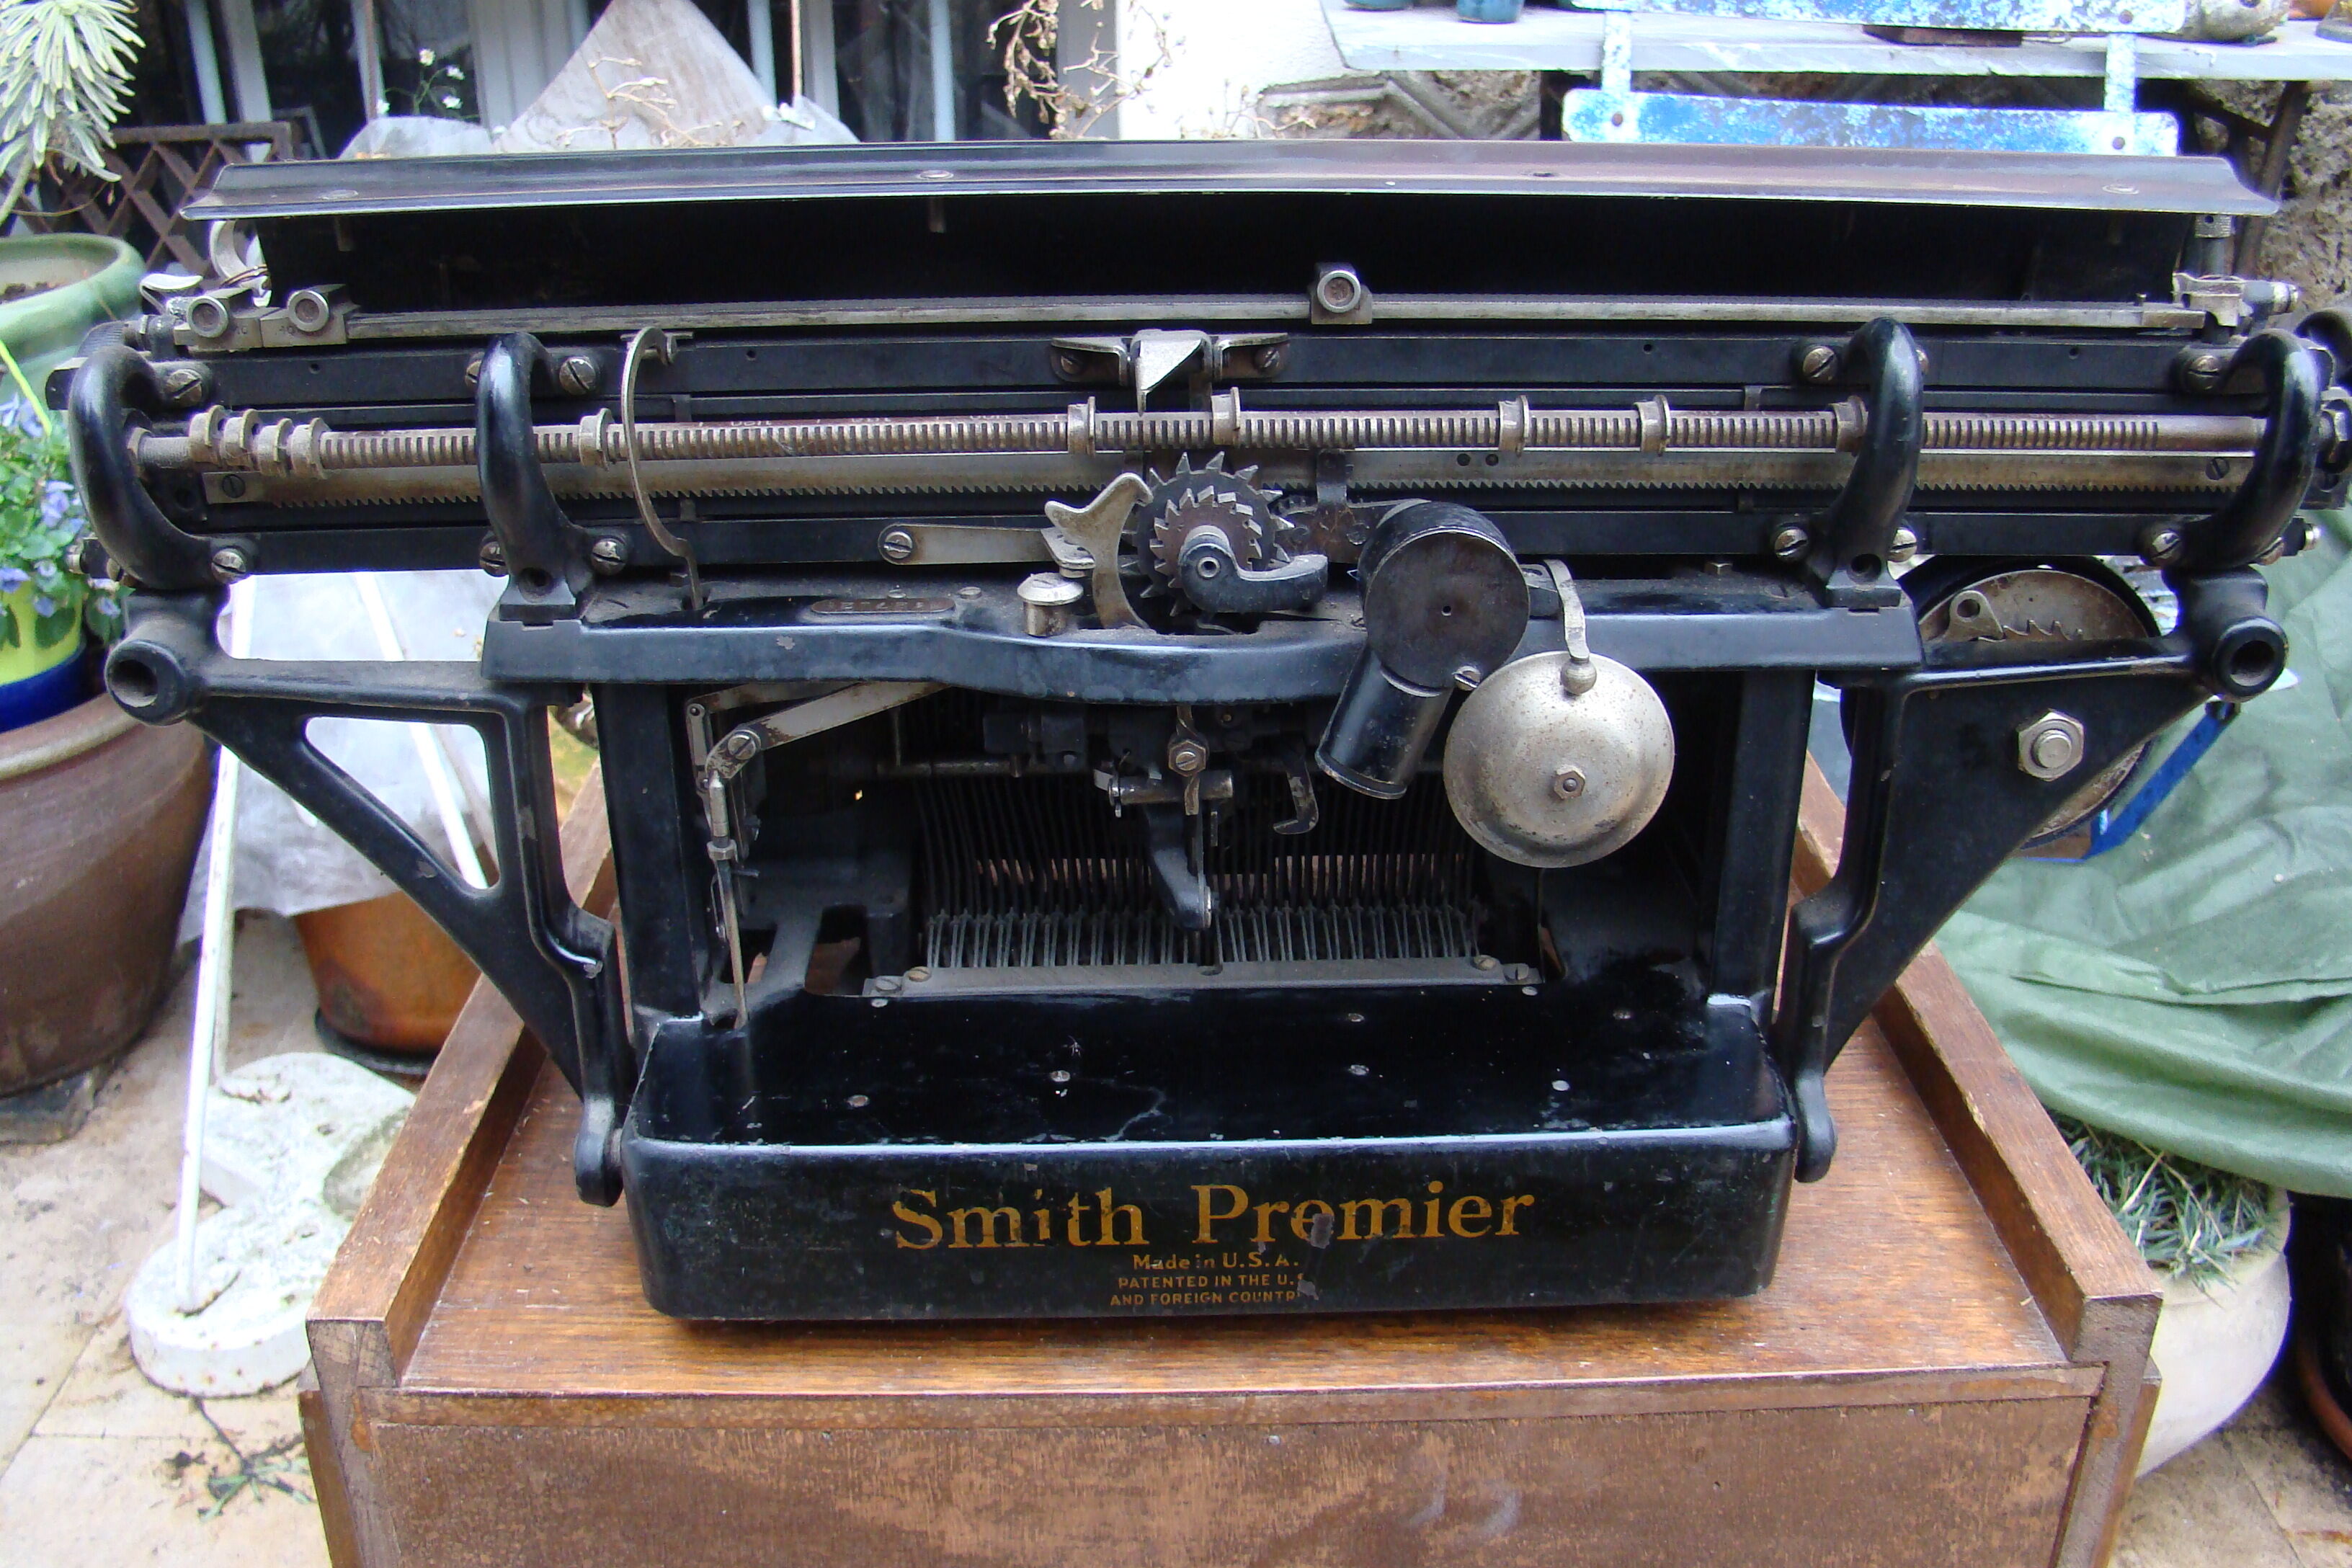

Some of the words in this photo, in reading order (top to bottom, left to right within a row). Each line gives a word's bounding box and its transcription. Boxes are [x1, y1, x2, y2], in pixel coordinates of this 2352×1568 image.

[892, 1186, 1150, 1250] Smith
[1190, 1180, 1536, 1244] Premier
[1132, 1253, 1190, 1270] Made
[1195, 1253, 1216, 1269] in
[1118, 1275, 1208, 1289] PATENTED
[1214, 1275, 1232, 1288] IN
[1237, 1273, 1270, 1287] THE
[1109, 1293, 1145, 1307] AND
[1149, 1291, 1223, 1306] FOREIGN
